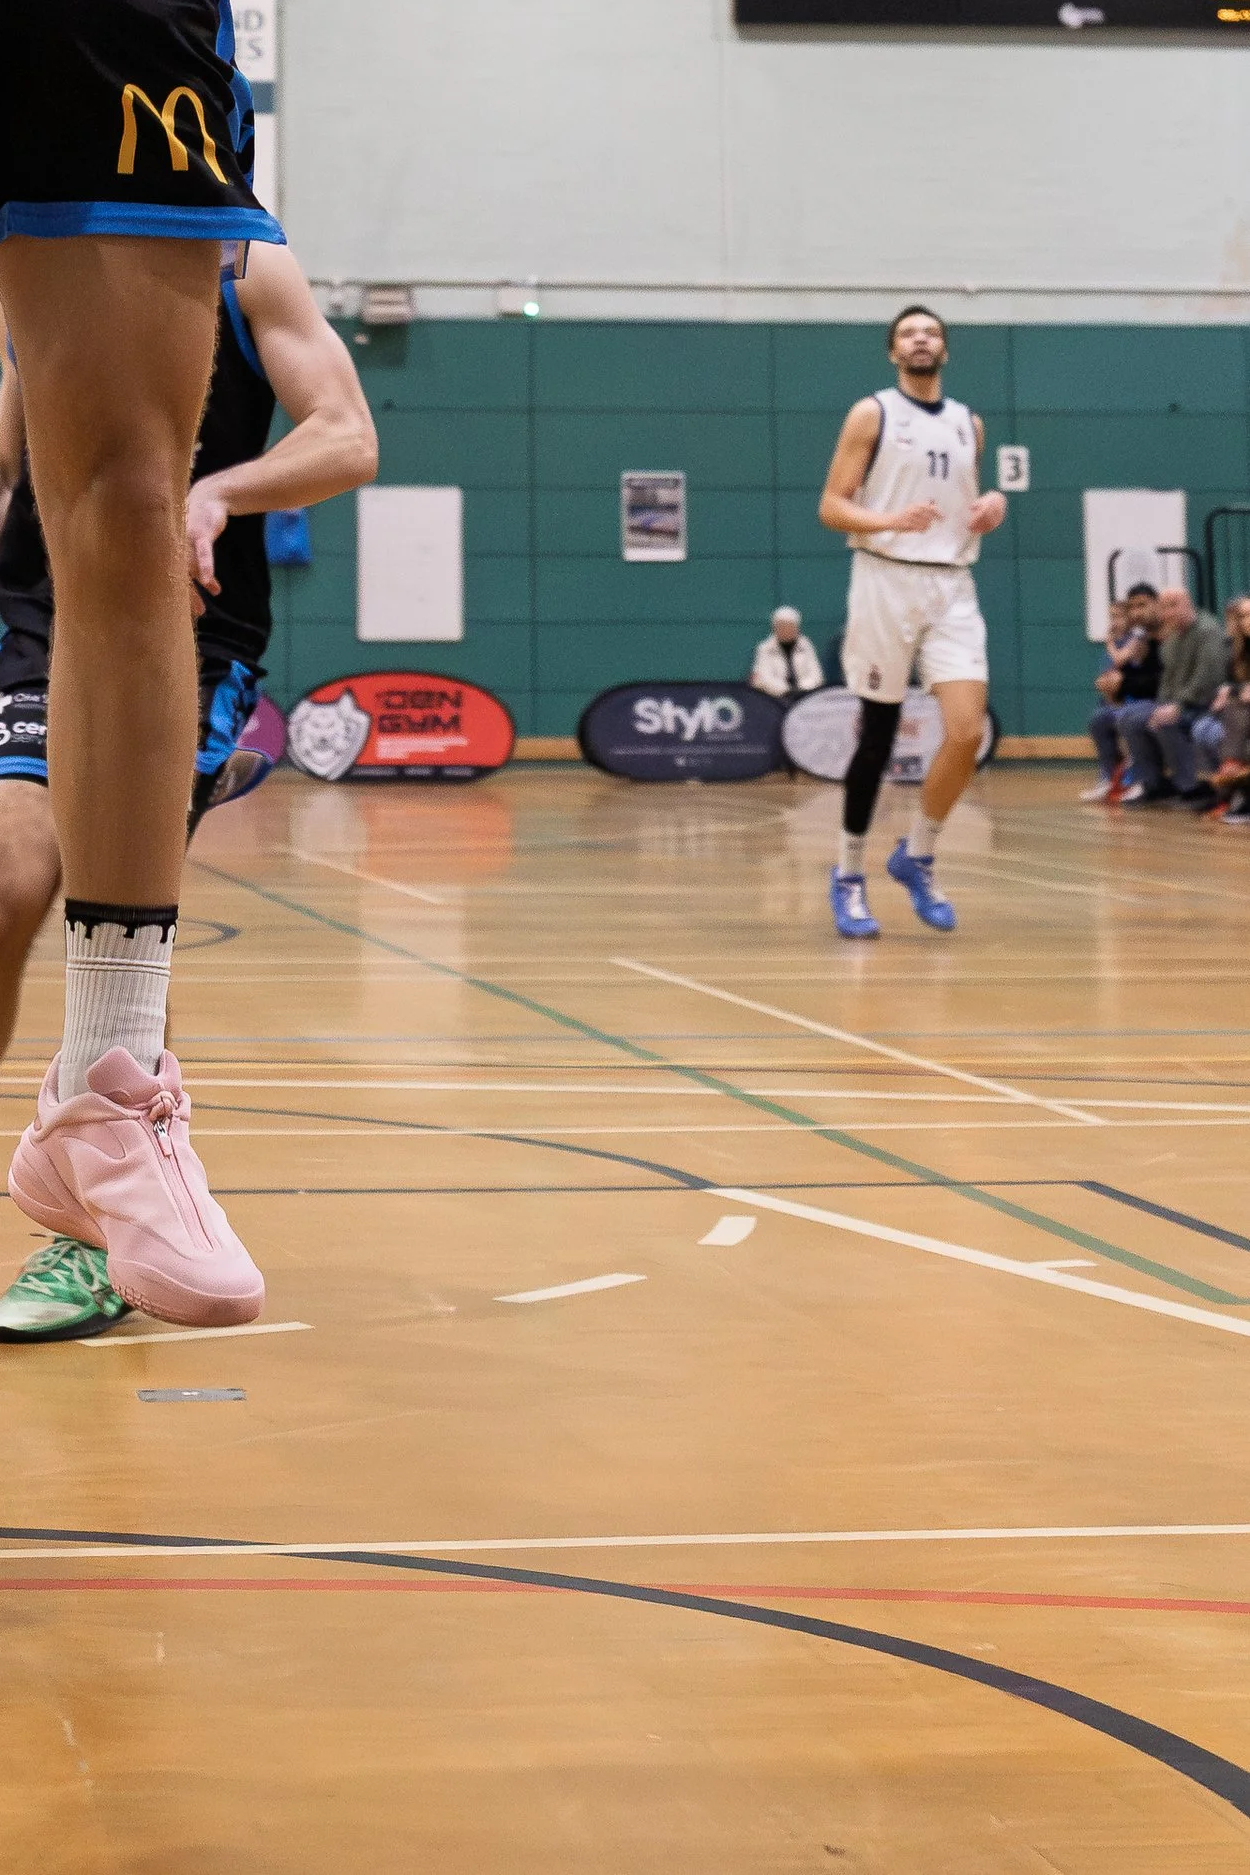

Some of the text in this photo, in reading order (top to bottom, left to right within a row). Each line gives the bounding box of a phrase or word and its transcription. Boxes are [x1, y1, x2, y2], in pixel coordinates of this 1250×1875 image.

[926, 450, 950, 481] 11
[1007, 454, 1022, 482] 3
[12, 721, 47, 736] cer
